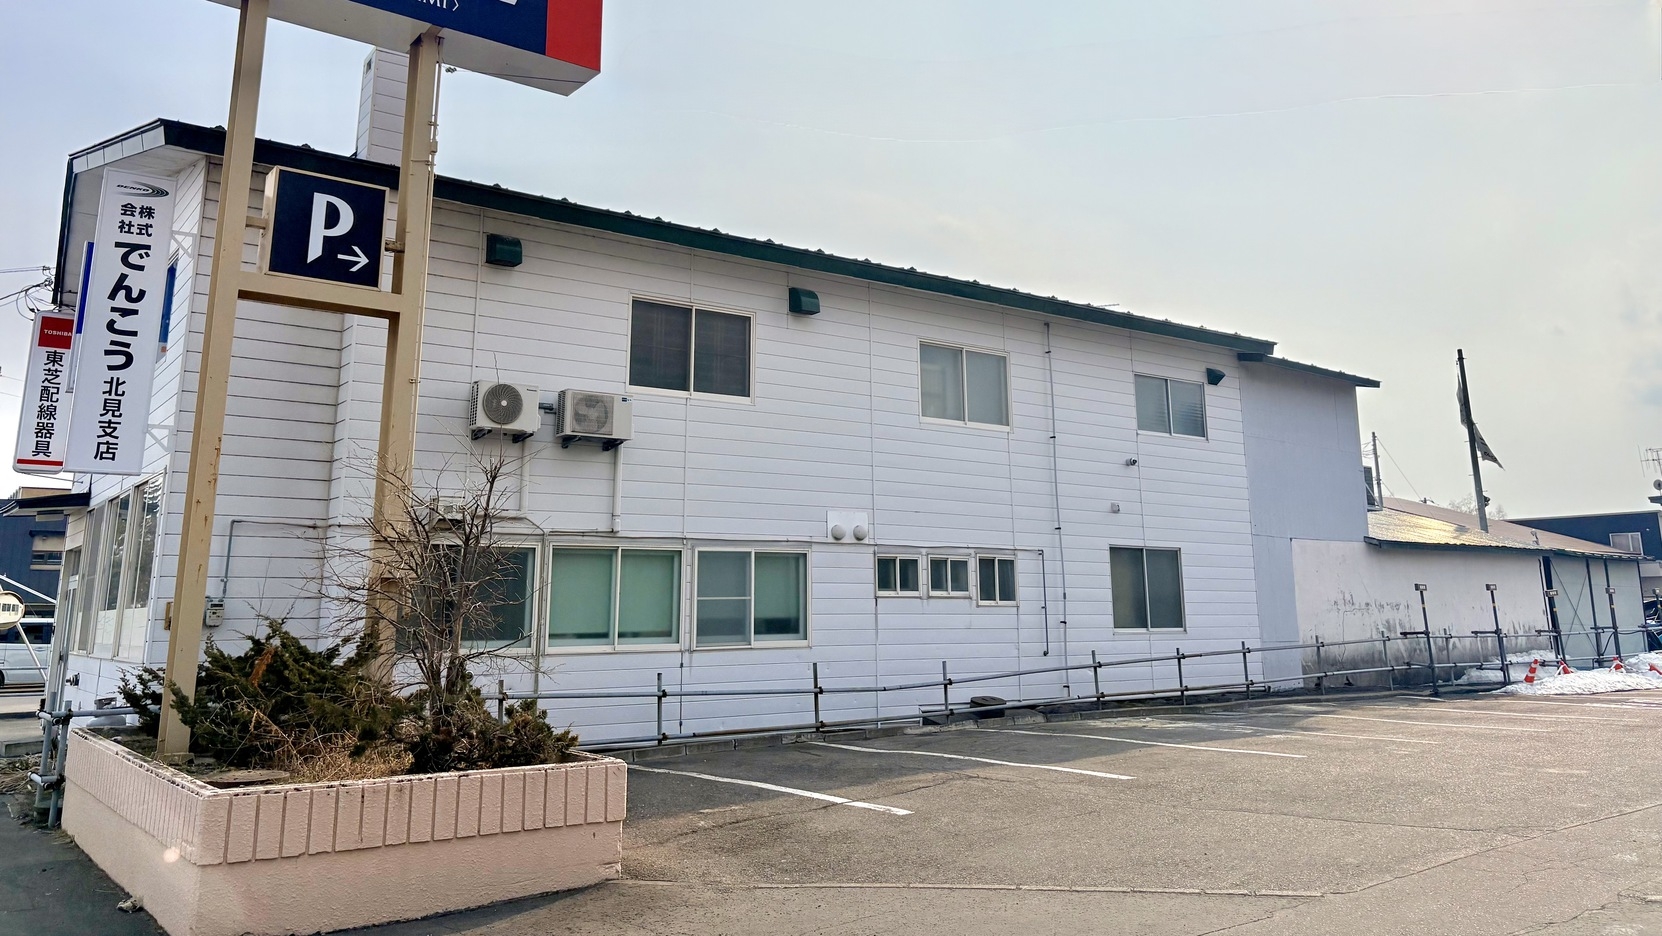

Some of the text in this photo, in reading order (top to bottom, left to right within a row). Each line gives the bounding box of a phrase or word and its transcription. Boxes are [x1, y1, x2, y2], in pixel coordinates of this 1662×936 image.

[307, 192, 354, 264] P
[43, 329, 73, 337] TOSHIBA
[31, 350, 66, 458] 東芝配線器具
